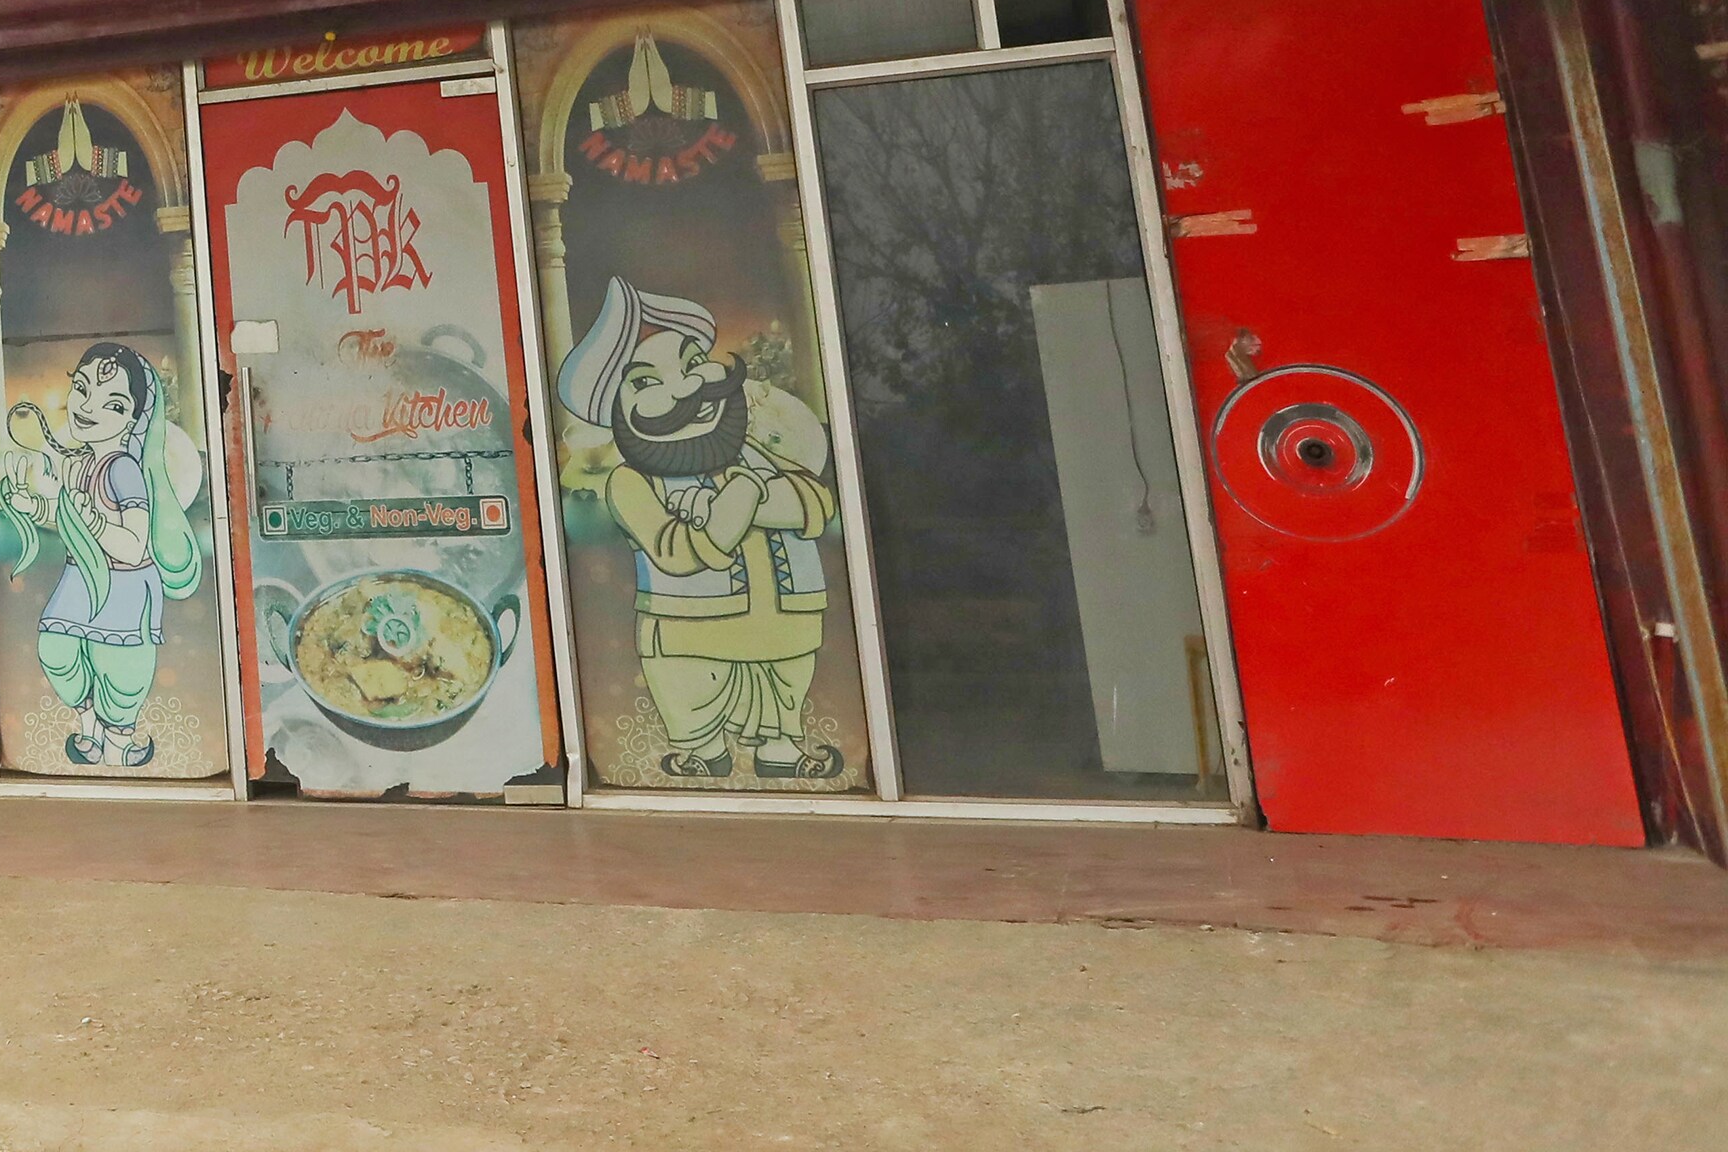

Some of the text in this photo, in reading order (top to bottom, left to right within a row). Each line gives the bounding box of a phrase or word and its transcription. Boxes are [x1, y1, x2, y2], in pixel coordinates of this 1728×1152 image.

[237, 36, 453, 81] Welcome
[578, 122, 737, 185] NAMASTE
[15, 178, 144, 236] NAMASTE
[288, 503, 478, 535] Veg. & Non-Veg.
